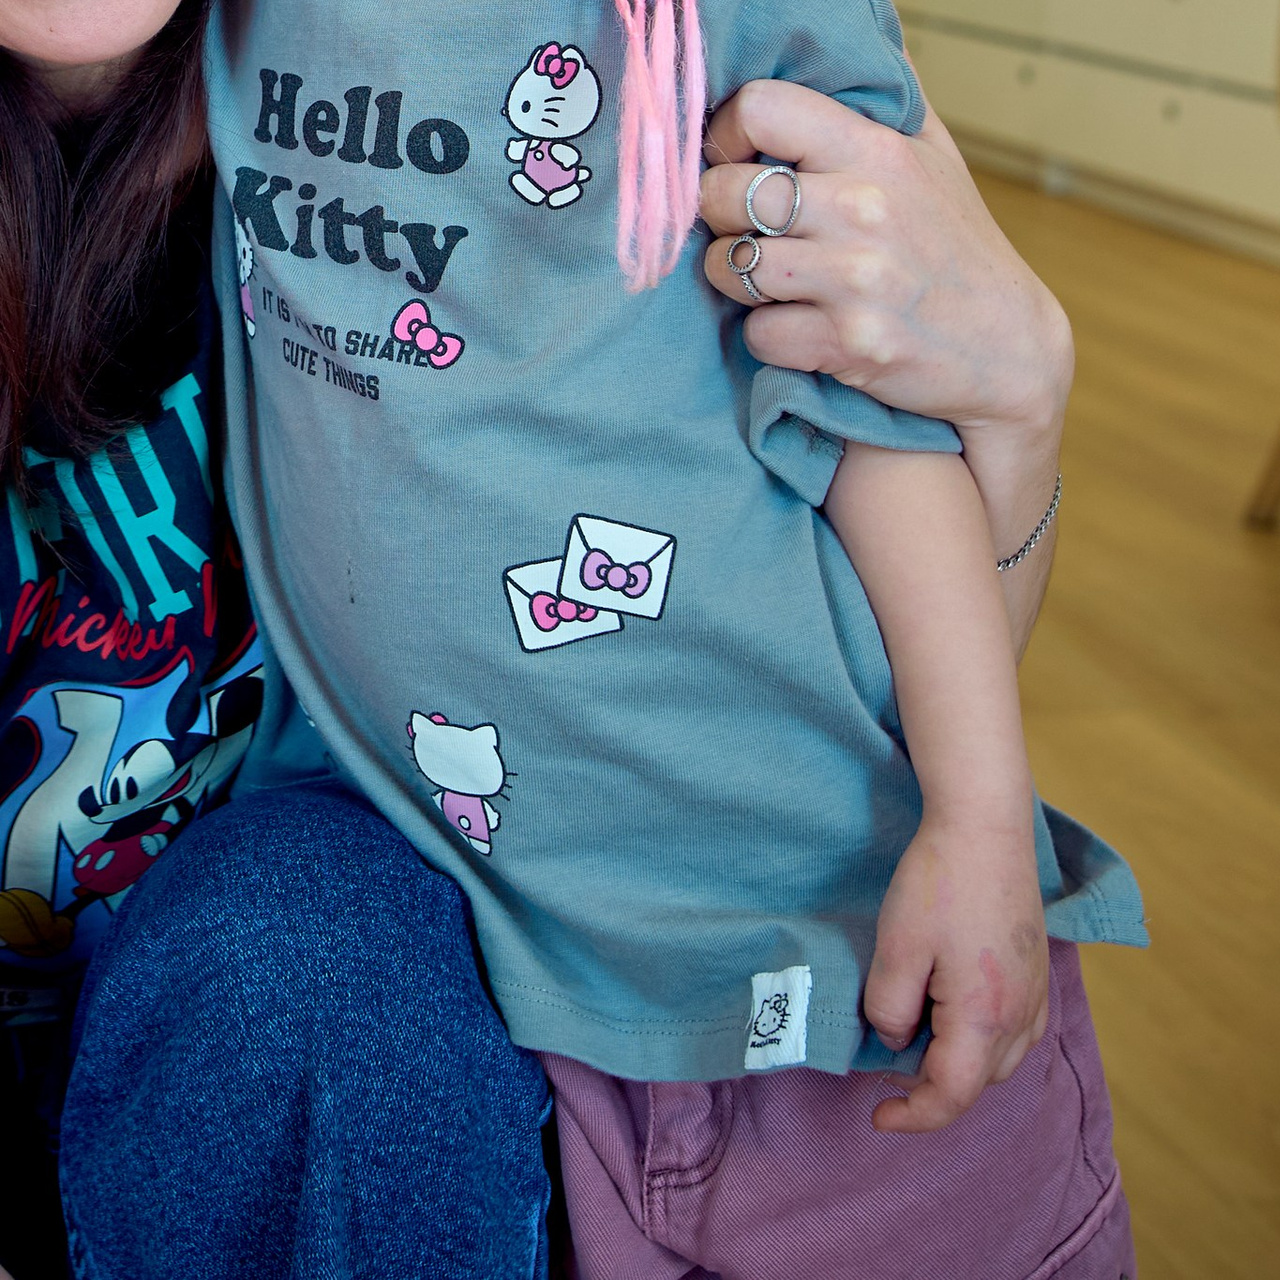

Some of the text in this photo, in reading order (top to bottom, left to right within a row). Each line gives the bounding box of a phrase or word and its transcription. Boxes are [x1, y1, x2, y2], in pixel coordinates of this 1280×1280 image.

[253, 68, 470, 174] Hello
[232, 166, 469, 293] Kitty
[263, 287, 273, 314] IT
[277, 295, 290, 323] IS
[312, 323, 337, 352] TO
[282, 337, 380, 401] CUTE THINGS
